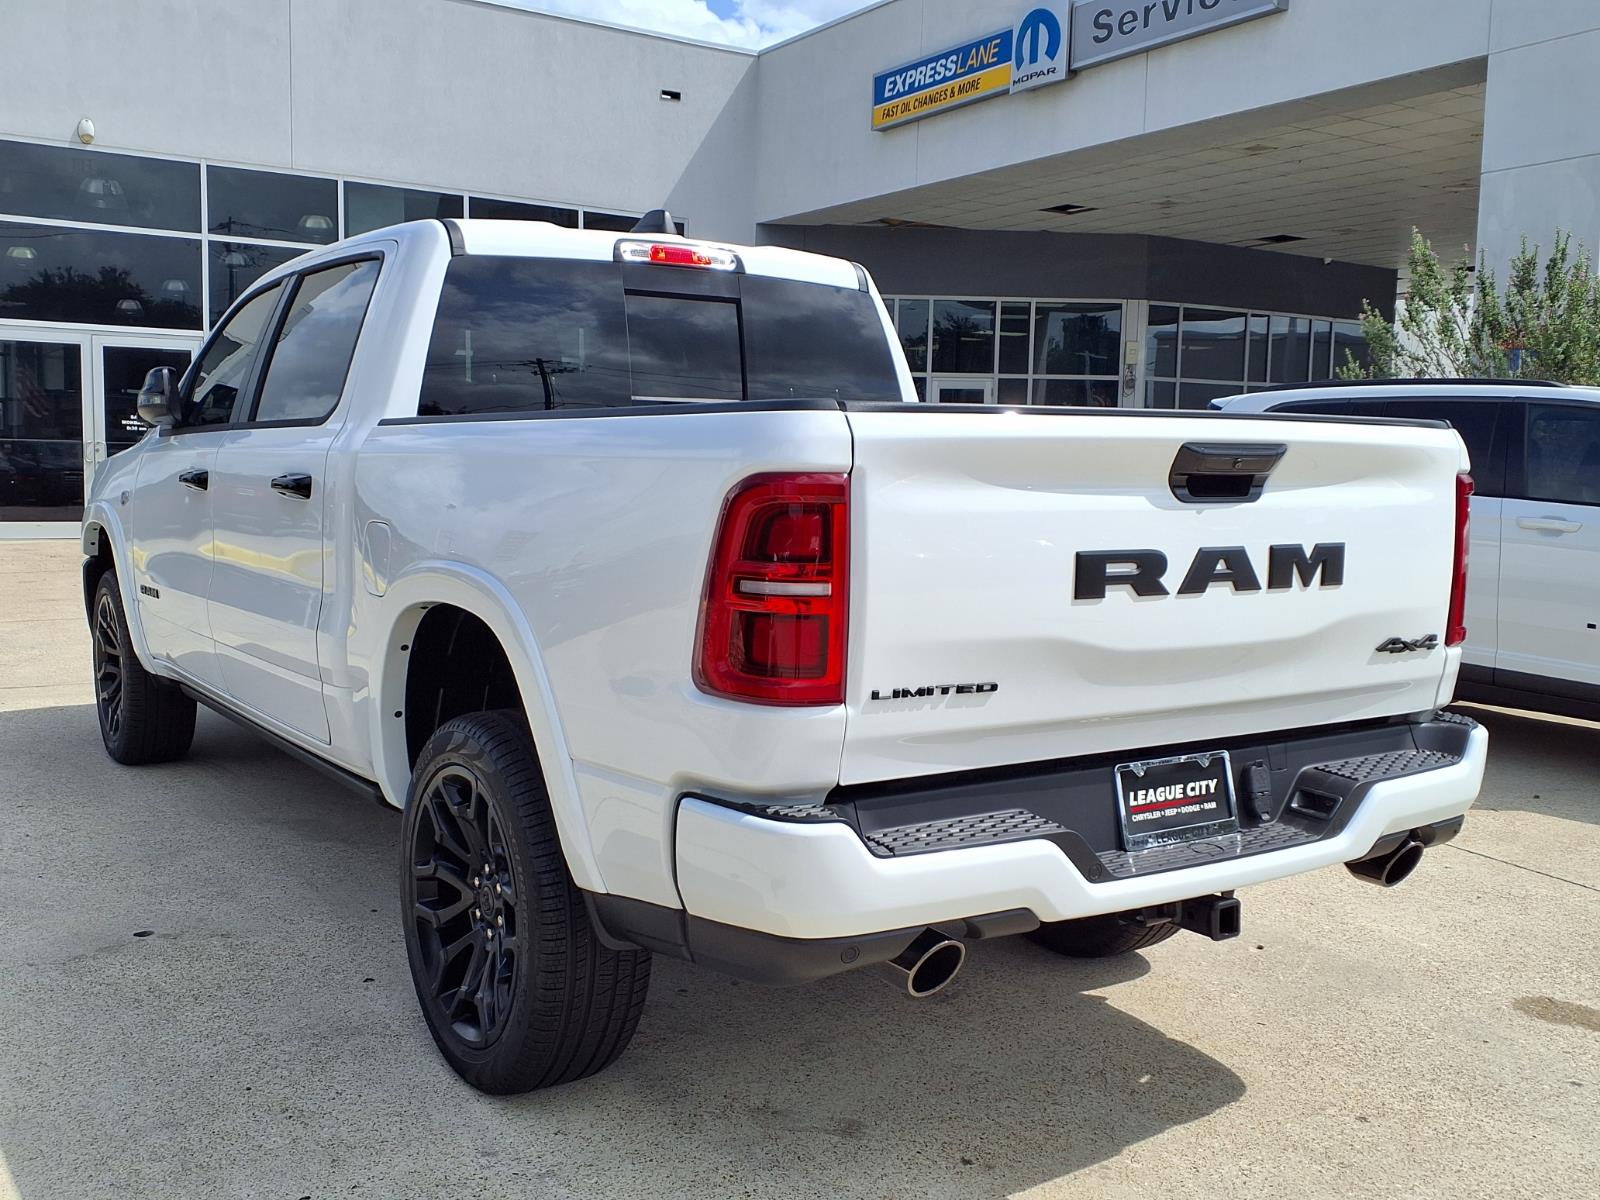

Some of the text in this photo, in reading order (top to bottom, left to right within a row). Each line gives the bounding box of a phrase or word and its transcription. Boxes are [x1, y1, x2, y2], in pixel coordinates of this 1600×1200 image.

[1012, 66, 1057, 86] MOPAR
[881, 77, 982, 120] FAST OIL CHANGES & MORE
[1074, 542, 1346, 600] RAM
[871, 682, 999, 700] LIMITED
[1129, 778, 1218, 806] LEAGUE CITY
[1131, 810, 1162, 822] CHRYSLER
[1181, 804, 1201, 814] DODGE
[1203, 801, 1217, 810] RAM
